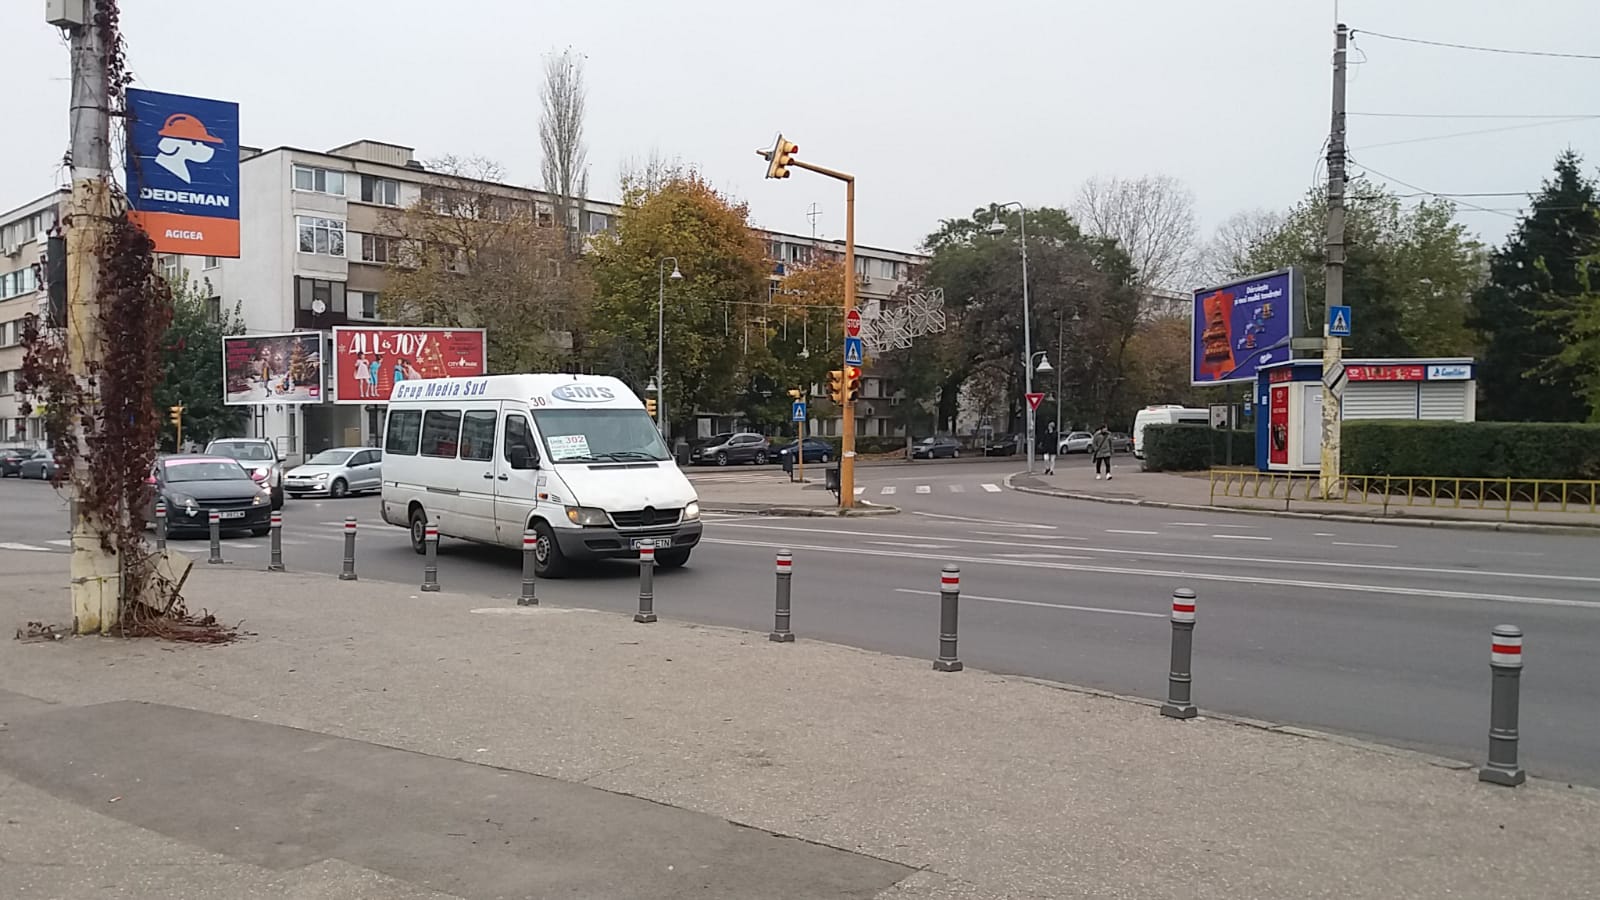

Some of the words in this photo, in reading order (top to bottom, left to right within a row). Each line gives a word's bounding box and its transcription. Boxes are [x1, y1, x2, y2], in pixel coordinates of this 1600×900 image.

[140, 187, 230, 207] DEDEMAN
[165, 229, 204, 240] AGIGEA
[847, 318, 861, 329] STOP
[348, 332, 385, 354] ALL
[390, 332, 428, 357] JOY
[397, 384, 423, 399] Grup
[425, 381, 461, 397] Media
[463, 380, 488, 396] Sud
[562, 385, 616, 399] GMS
[566, 435, 585, 444] 302
